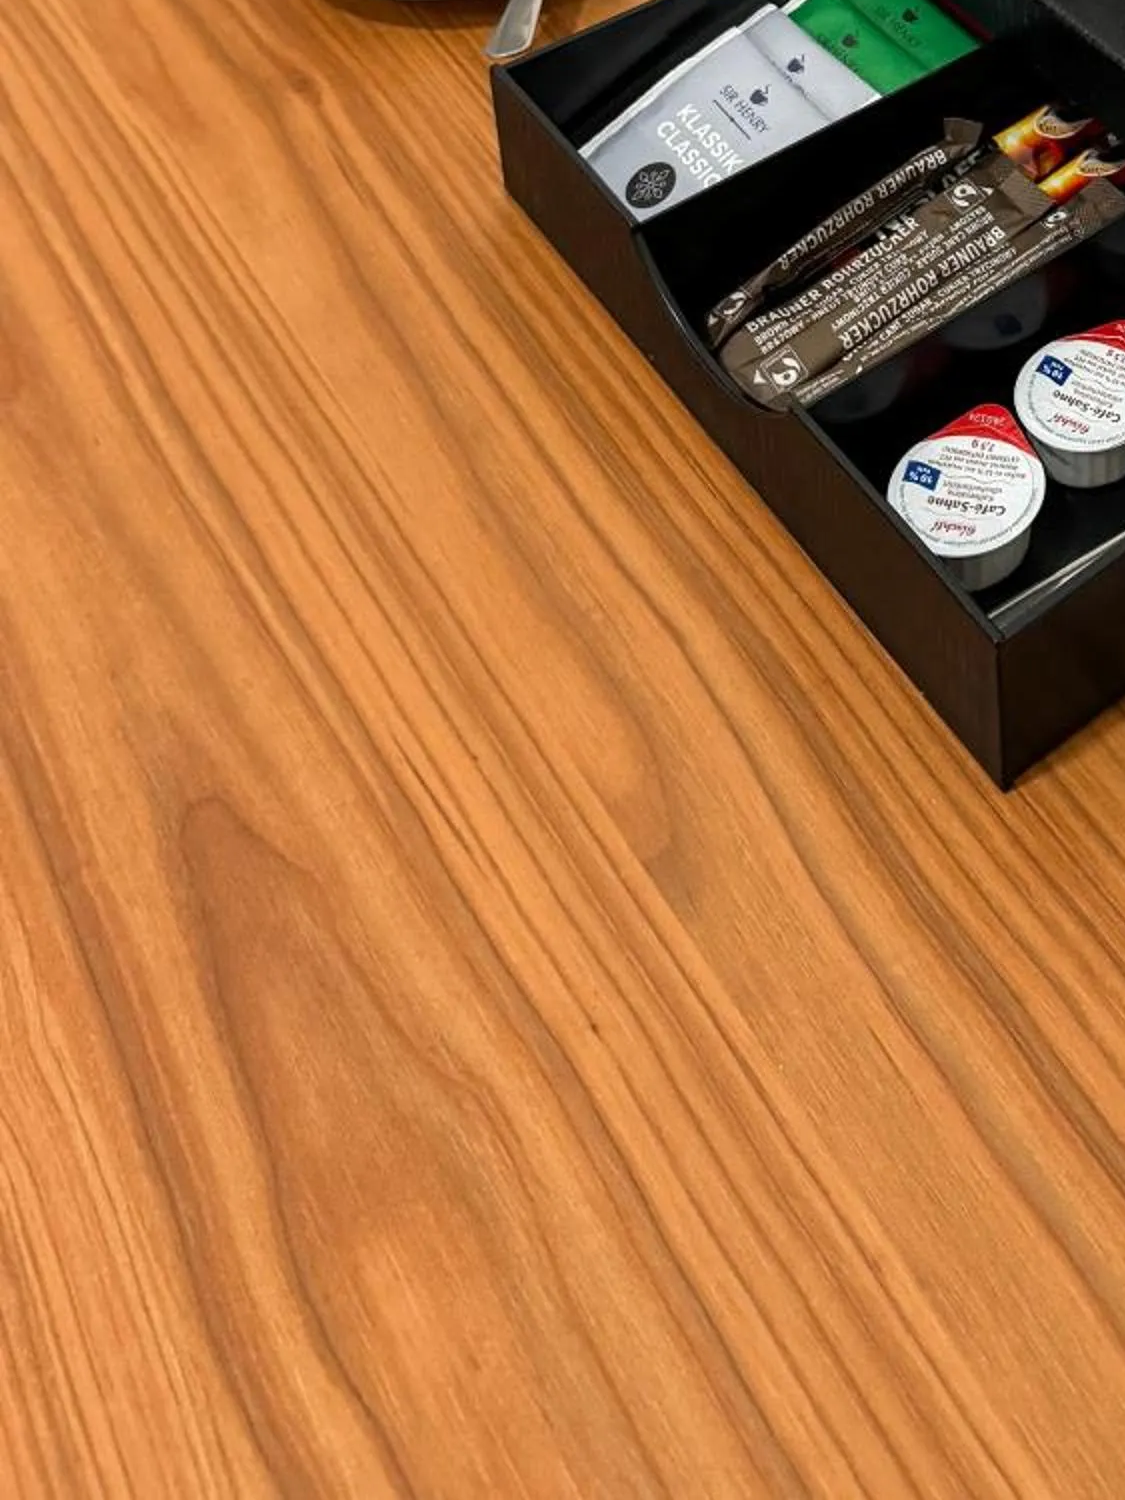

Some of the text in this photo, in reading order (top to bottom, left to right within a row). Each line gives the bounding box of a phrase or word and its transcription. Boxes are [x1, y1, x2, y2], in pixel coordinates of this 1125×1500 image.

[675, 101, 744, 175] KLASSIK
[733, 98, 770, 136] HENRY
[873, 148, 949, 200] BRAUNER
[776, 191, 877, 271] ROHRZUCKER
[936, 225, 1005, 279] BRAUNER
[745, 286, 823, 333] BRAUNER
[836, 268, 940, 350] ROHRZUCKER
[926, 494, 1005, 517] Café-Sahne
